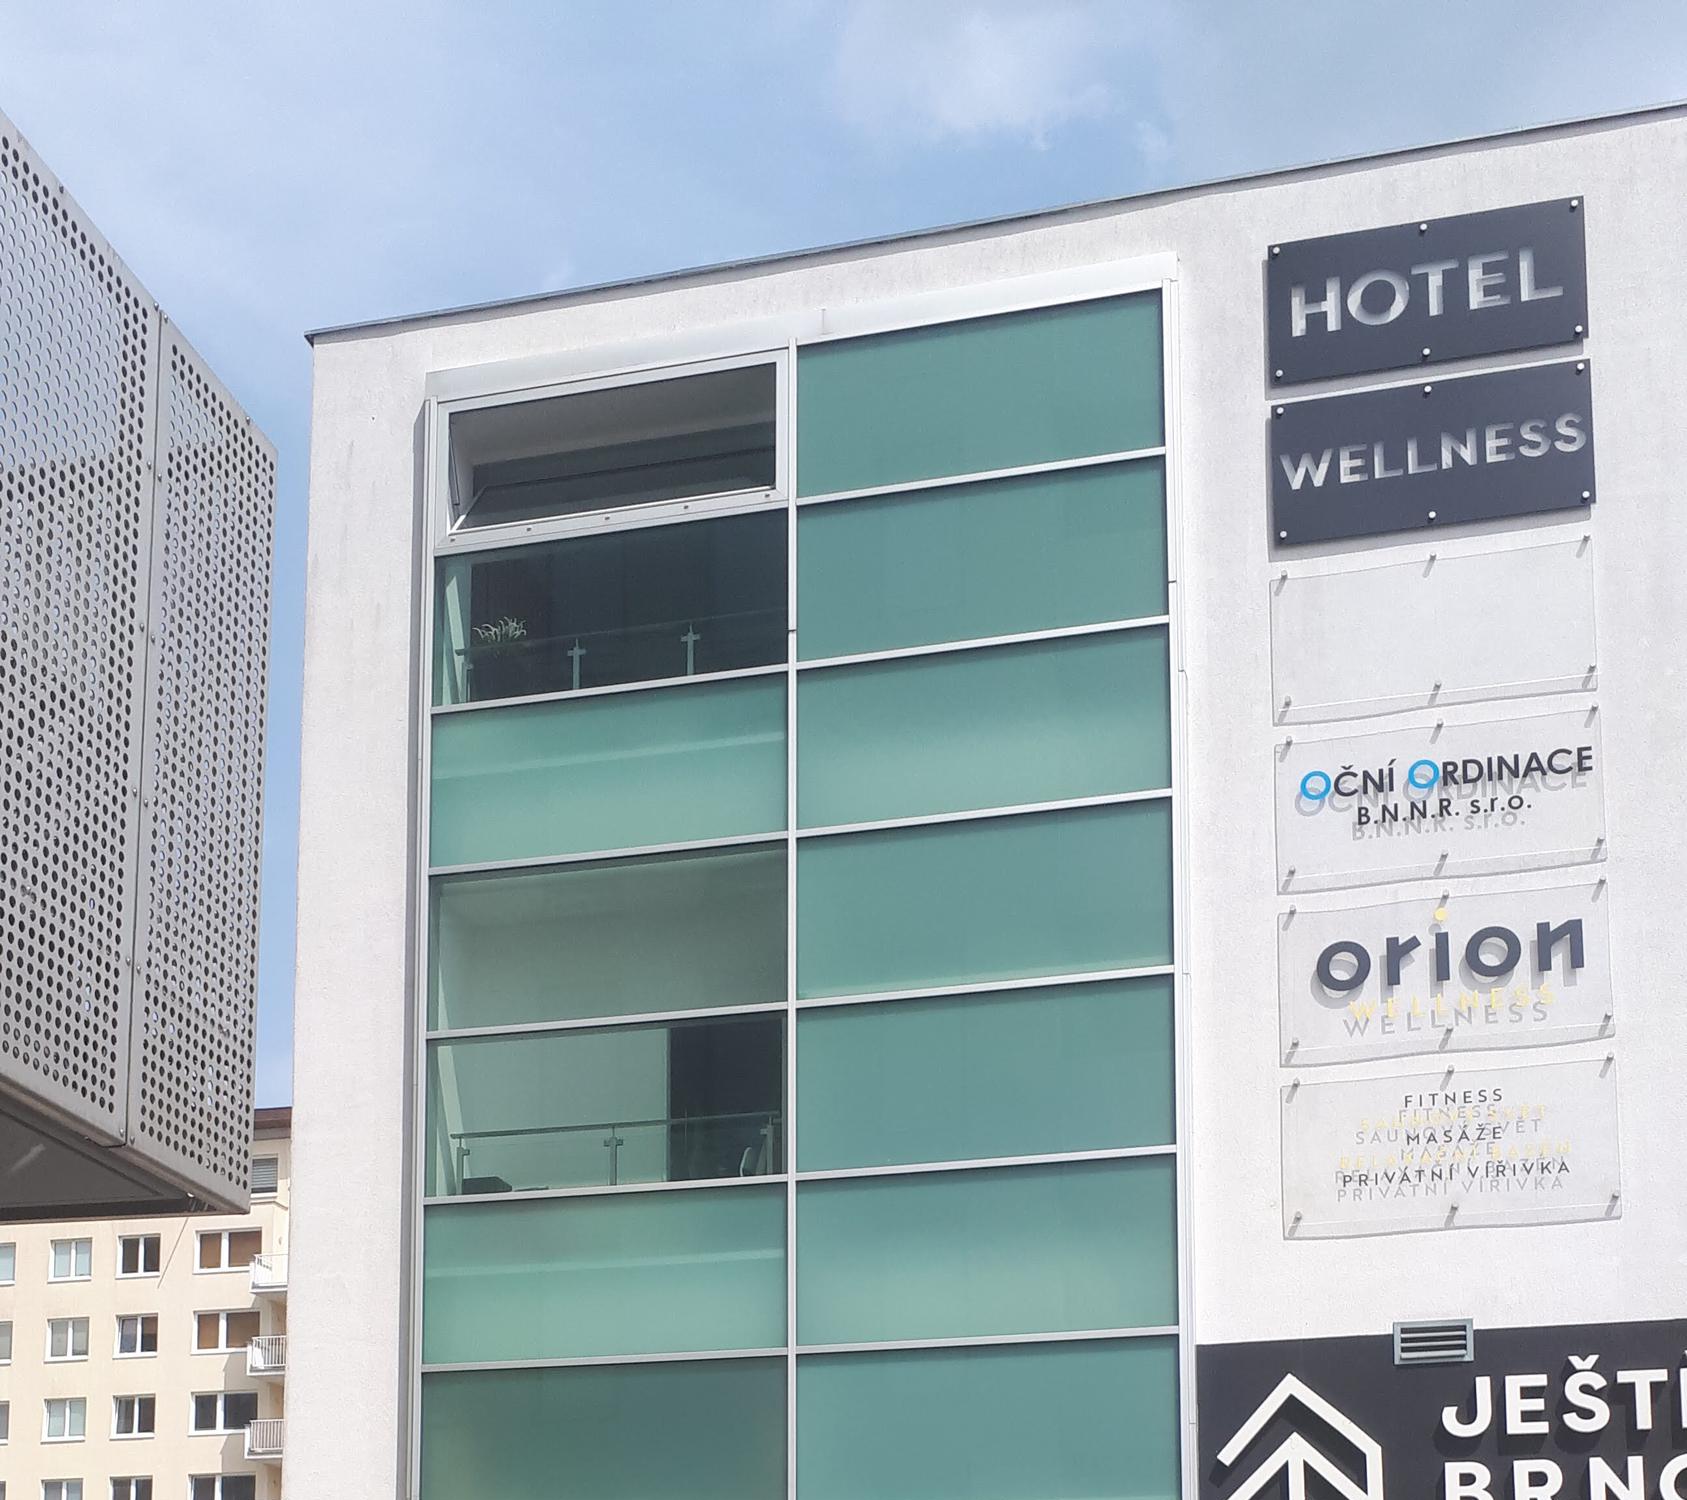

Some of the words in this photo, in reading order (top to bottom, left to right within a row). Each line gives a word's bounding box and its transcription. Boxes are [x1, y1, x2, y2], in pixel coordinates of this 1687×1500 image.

[1291, 246, 1564, 337] HOTEL
[1279, 412, 1587, 490] WELLNESS
[1301, 758, 1397, 800] OČNÍ
[1407, 746, 1593, 790] ORDINACE
[1357, 798, 1460, 826] B.N.N.R.
[1470, 794, 1533, 815] s.r.o.
[1317, 907, 1585, 991] orion
[1404, 1088, 1503, 1108] FITNESS
[1406, 1123, 1503, 1146] MASÁŽE
[1343, 1163, 1454, 1188] PRIVÁTNÍ
[1467, 1159, 1570, 1178] VÍŘIVKA
[1442, 1351, 1687, 1438] JEŠT
